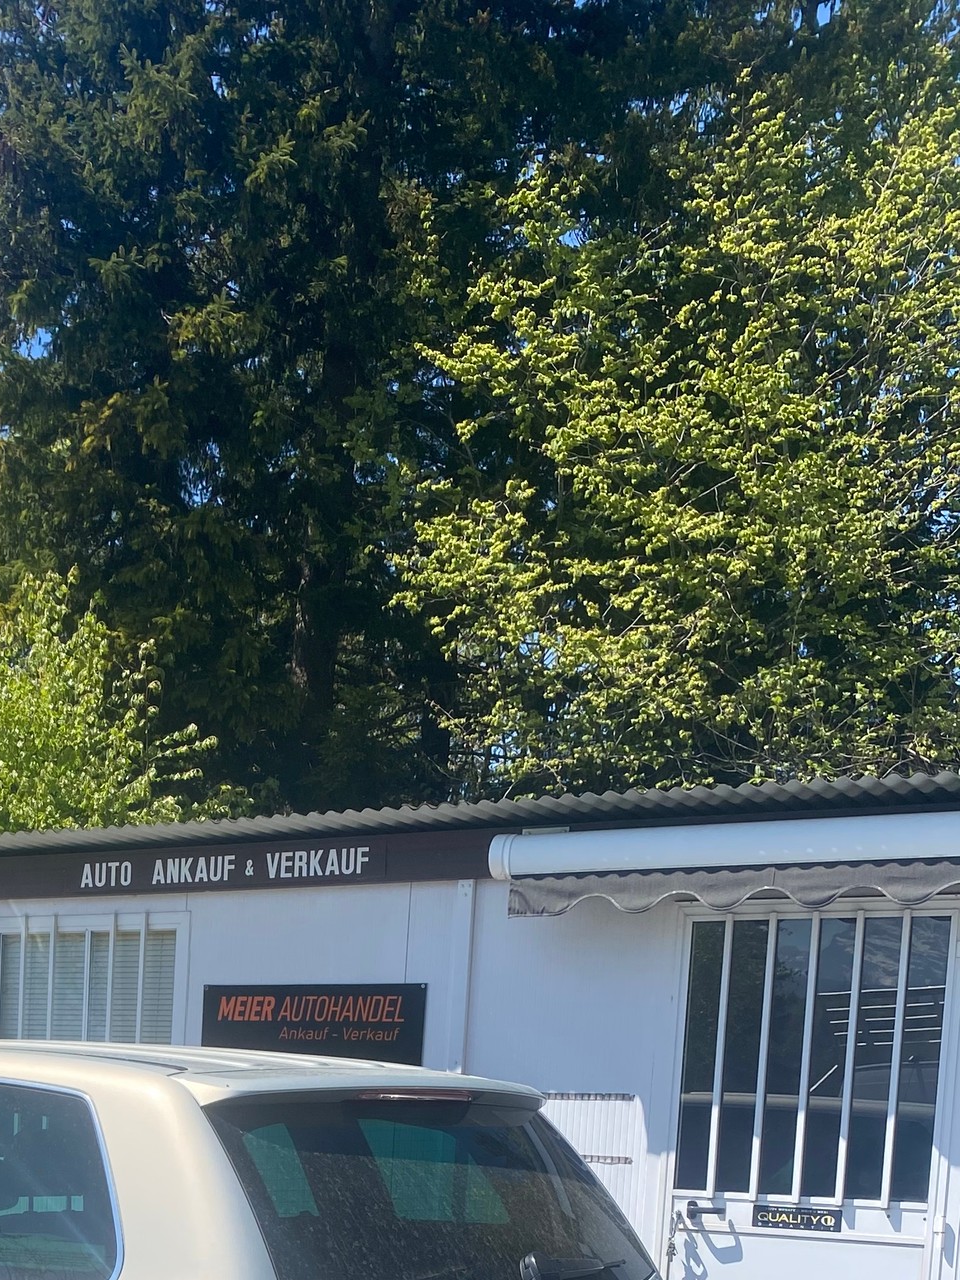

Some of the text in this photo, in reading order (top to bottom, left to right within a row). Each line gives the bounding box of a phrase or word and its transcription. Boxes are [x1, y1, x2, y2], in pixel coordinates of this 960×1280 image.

[80, 846, 370, 888] AUTO ANKAUF & VERKAUF
[217, 995, 405, 1023] MEIER AUTOHANDEL
[279, 1026, 329, 1041] Ankauf
[342, 1027, 400, 1042] Verkauf
[757, 1212, 820, 1225] QUALITY
